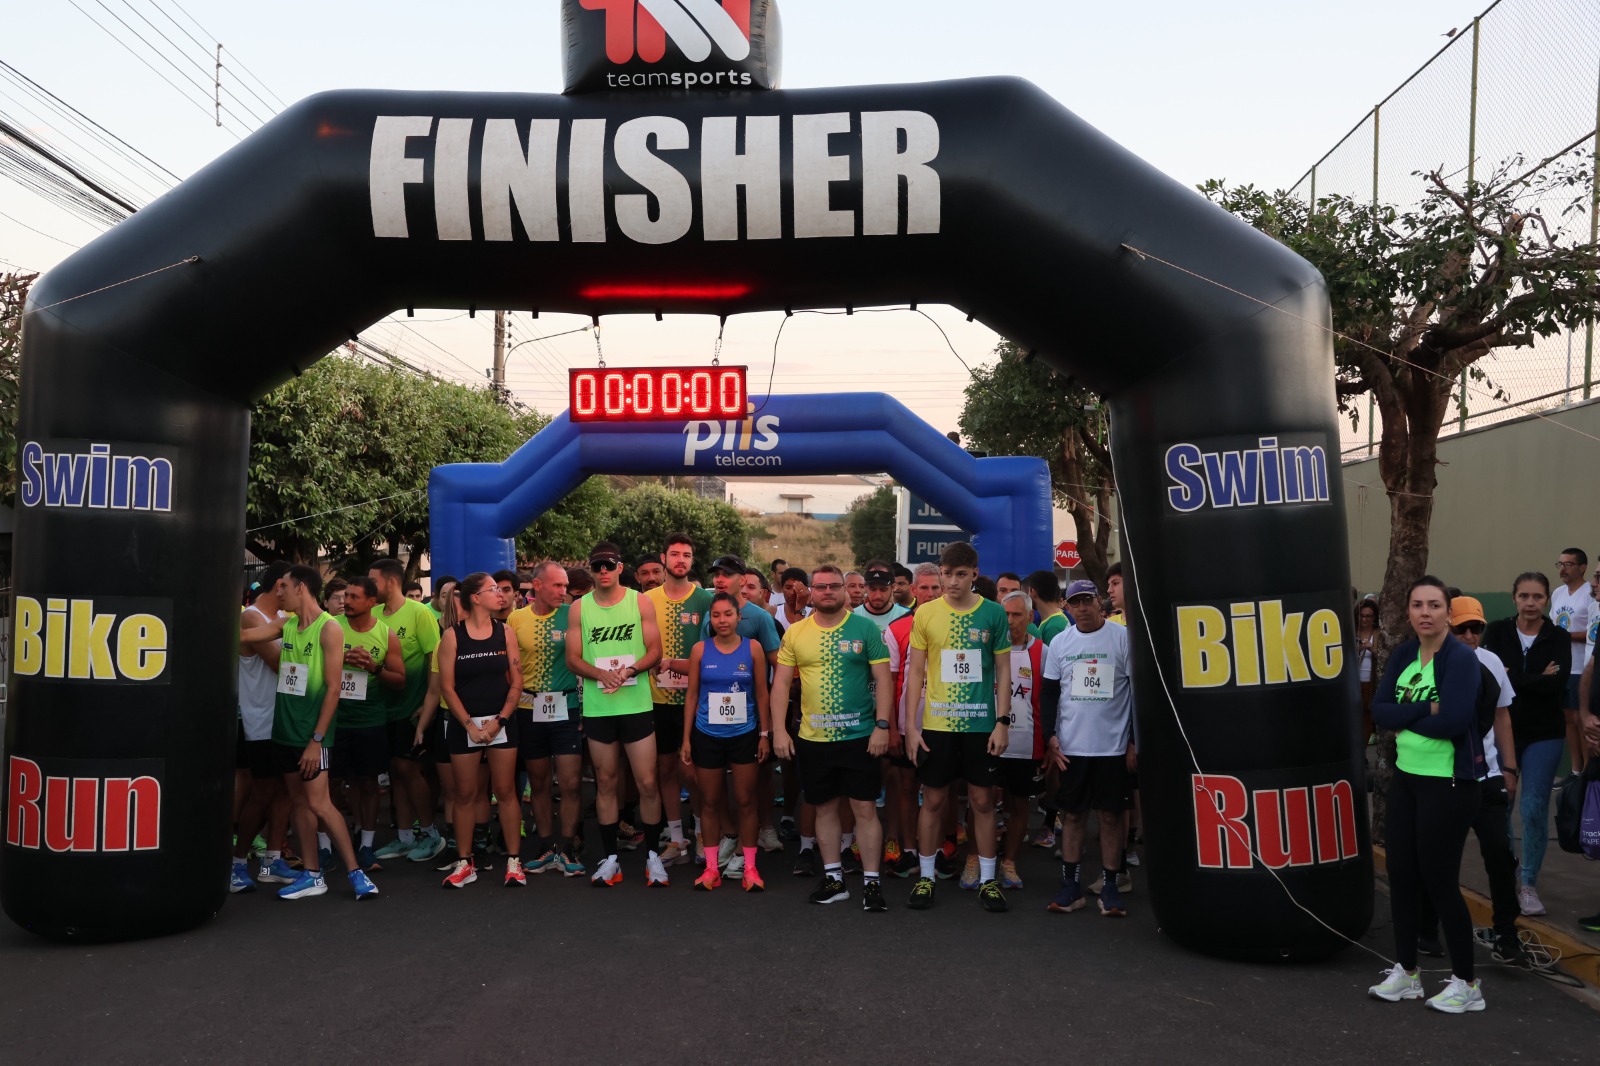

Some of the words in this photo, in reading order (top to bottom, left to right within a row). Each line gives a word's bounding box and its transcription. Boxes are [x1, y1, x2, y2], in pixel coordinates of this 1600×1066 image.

[607, 70, 752, 89] teamsports
[370, 110, 940, 244] FINISHER
[576, 372, 740, 414] 00:00:00
[715, 452, 782, 466] telecom
[21, 441, 174, 512] Swim
[1165, 437, 1330, 512] Swim
[1056, 550, 1080, 559] PARE
[13, 596, 168, 681] Bike
[590, 623, 636, 643] ELITE
[1176, 600, 1343, 688] Bike
[953, 662, 970, 674] 158
[285, 674, 298, 686] 067
[341, 681, 356, 692] 028
[1083, 676, 1101, 688] 064
[542, 703, 556, 714] 011
[720, 705, 735, 716] 050
[6, 755, 161, 853] Run
[1191, 773, 1359, 869] Run
